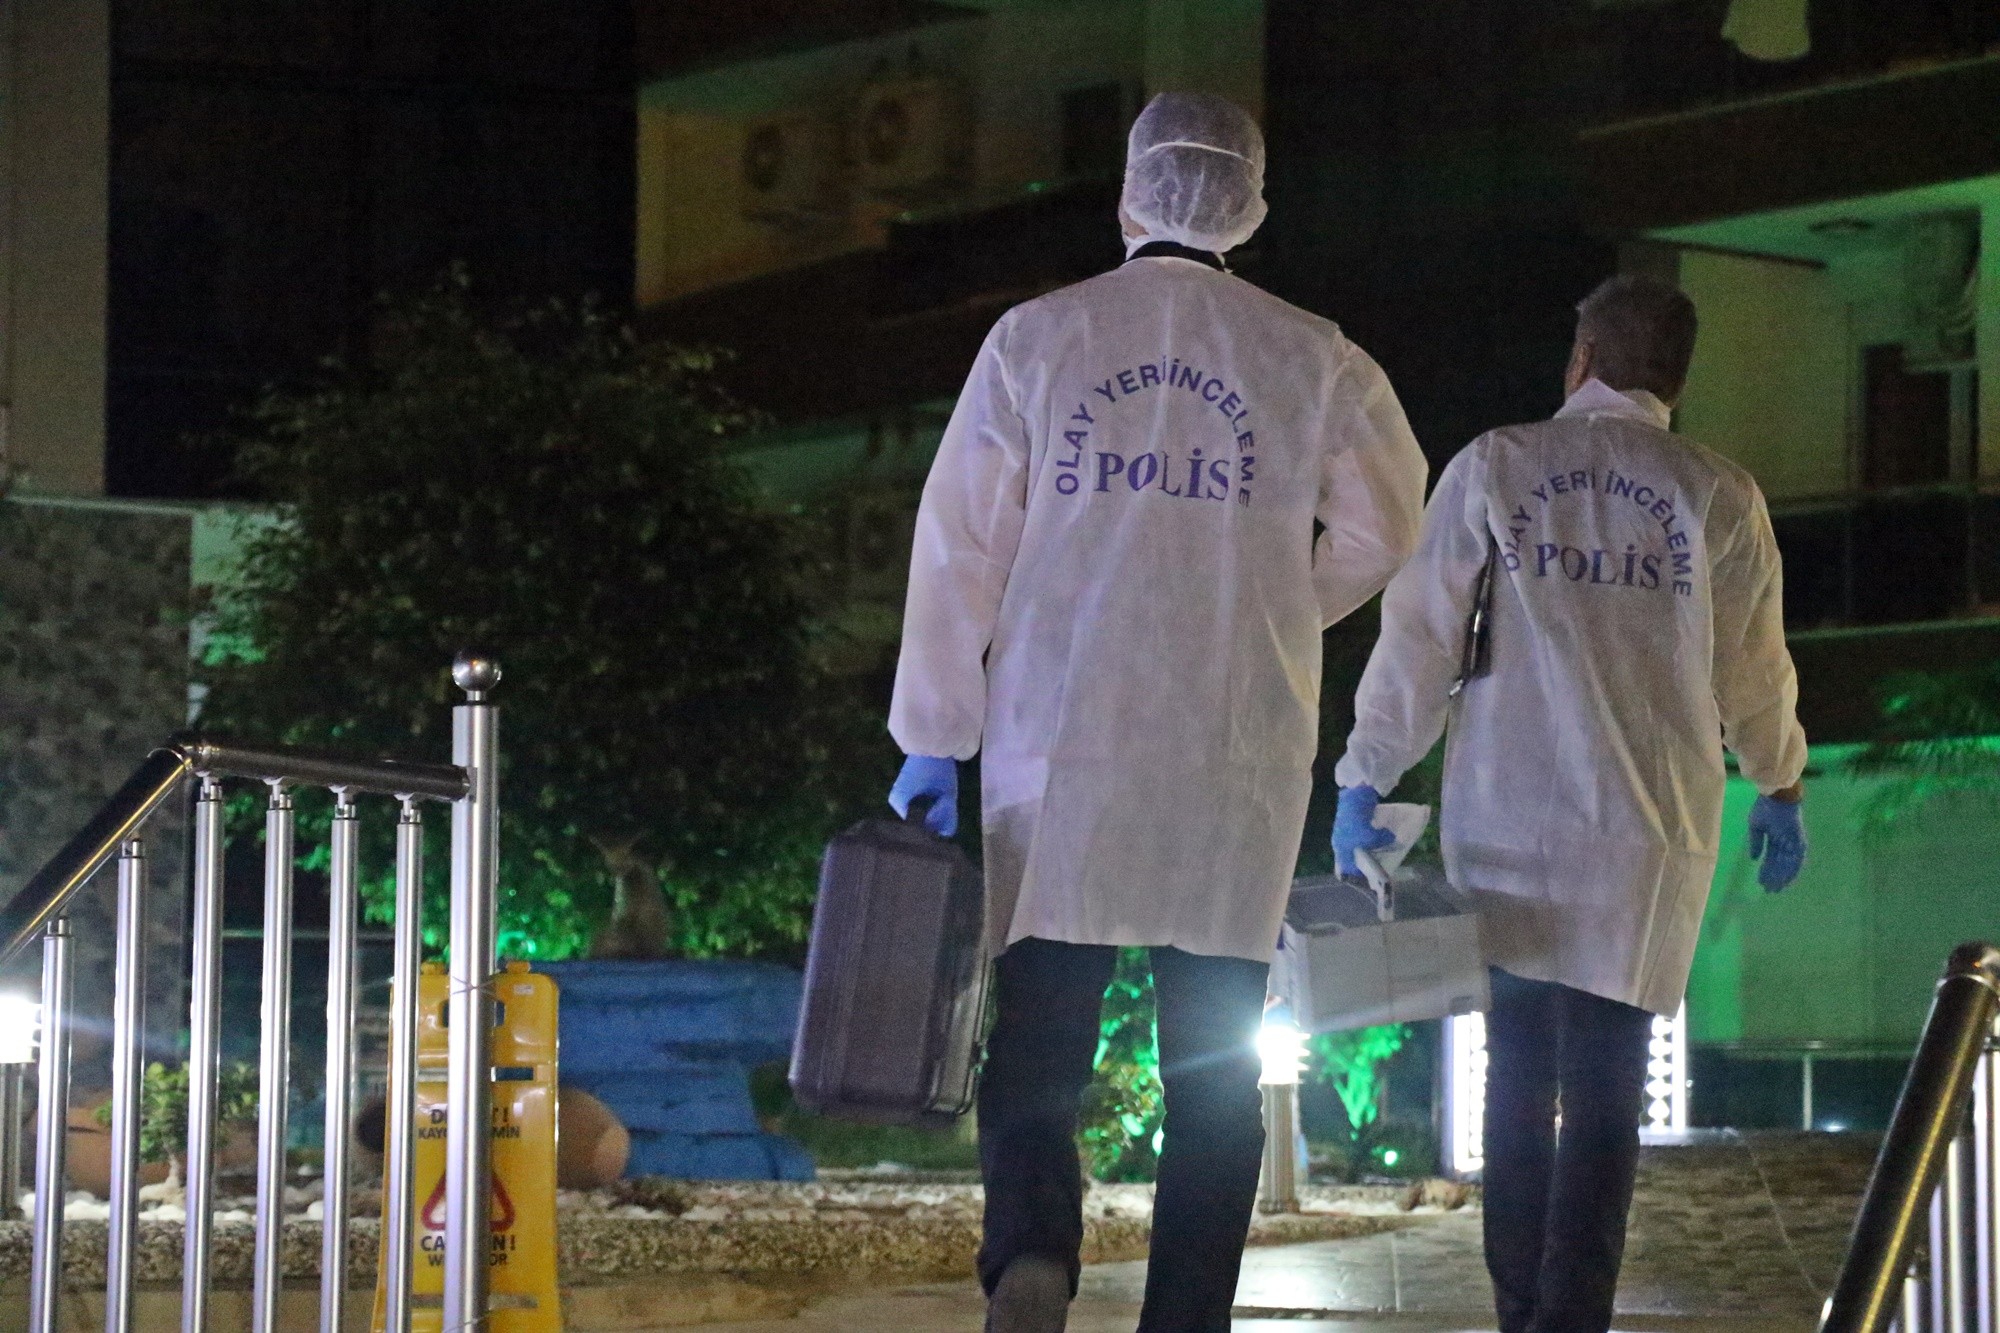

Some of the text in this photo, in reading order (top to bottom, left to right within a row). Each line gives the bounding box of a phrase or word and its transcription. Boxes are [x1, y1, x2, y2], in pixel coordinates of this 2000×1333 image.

[1055, 401, 1095, 495] OLAY
[1168, 357, 1256, 507] İNCELEME
[1093, 447, 1231, 501] POLİS
[1504, 504, 1532, 572] OLAY
[1604, 468, 1692, 597] İNCELEME
[1533, 543, 1662, 590] POLİS
